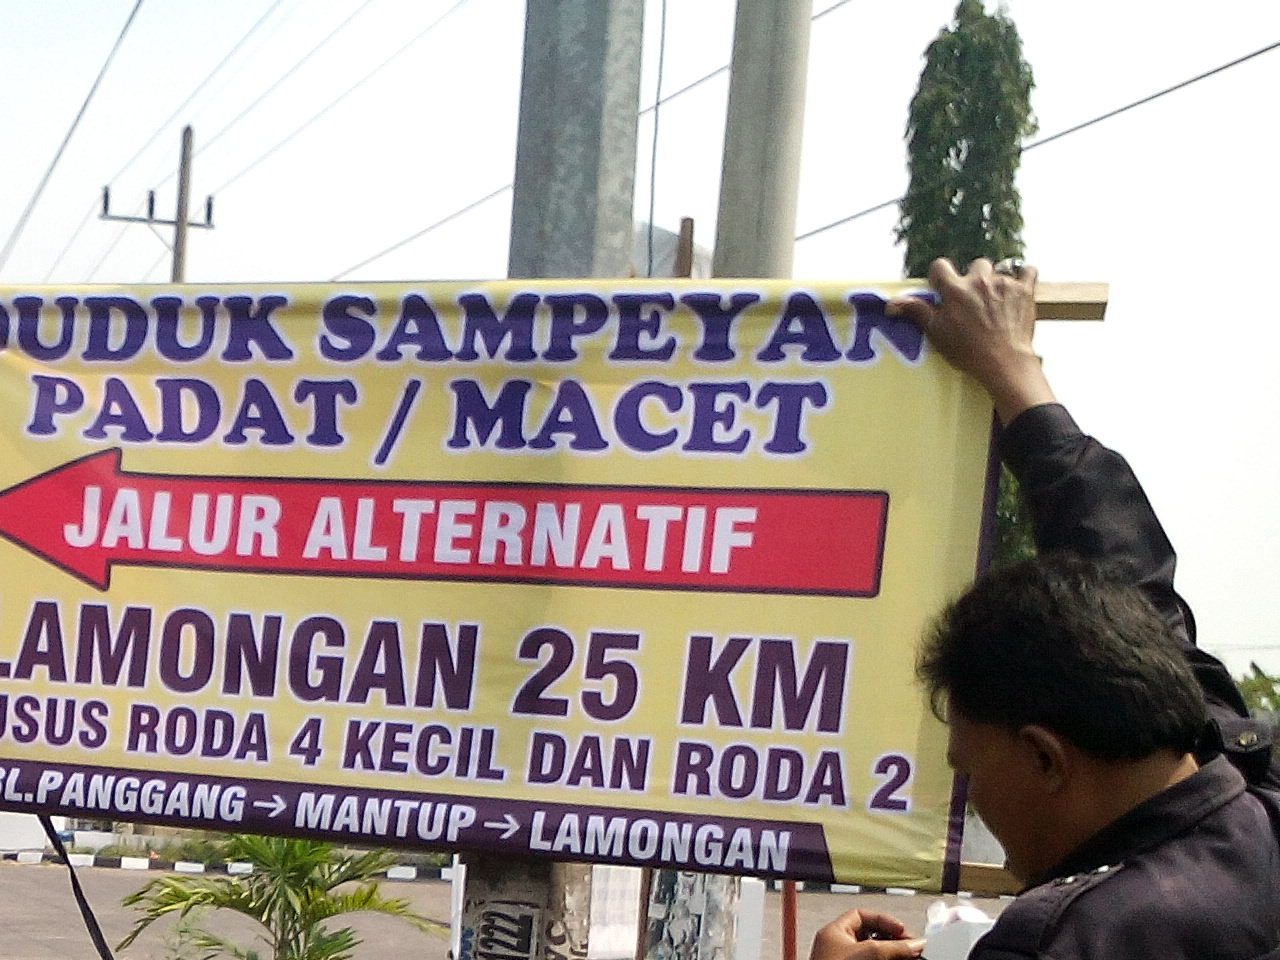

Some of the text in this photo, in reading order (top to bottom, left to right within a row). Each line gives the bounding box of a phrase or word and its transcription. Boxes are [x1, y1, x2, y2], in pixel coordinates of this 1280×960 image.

[319, 292, 936, 363] SAMPEYAN
[27, 374, 828, 466] PADAT / MACET
[63, 486, 758, 575] JALUR ALTERNATIF
[511, 626, 641, 722] 25
[680, 635, 850, 735] KM
[127, 704, 270, 763] RODA
[289, 717, 323, 766] 4
[342, 719, 505, 782] KECIL
[526, 731, 651, 792] DAN
[673, 741, 848, 808] RODA
[869, 755, 912, 812] 2
[294, 792, 477, 844] MANTUP
[527, 803, 792, 872] LAMONGAN
